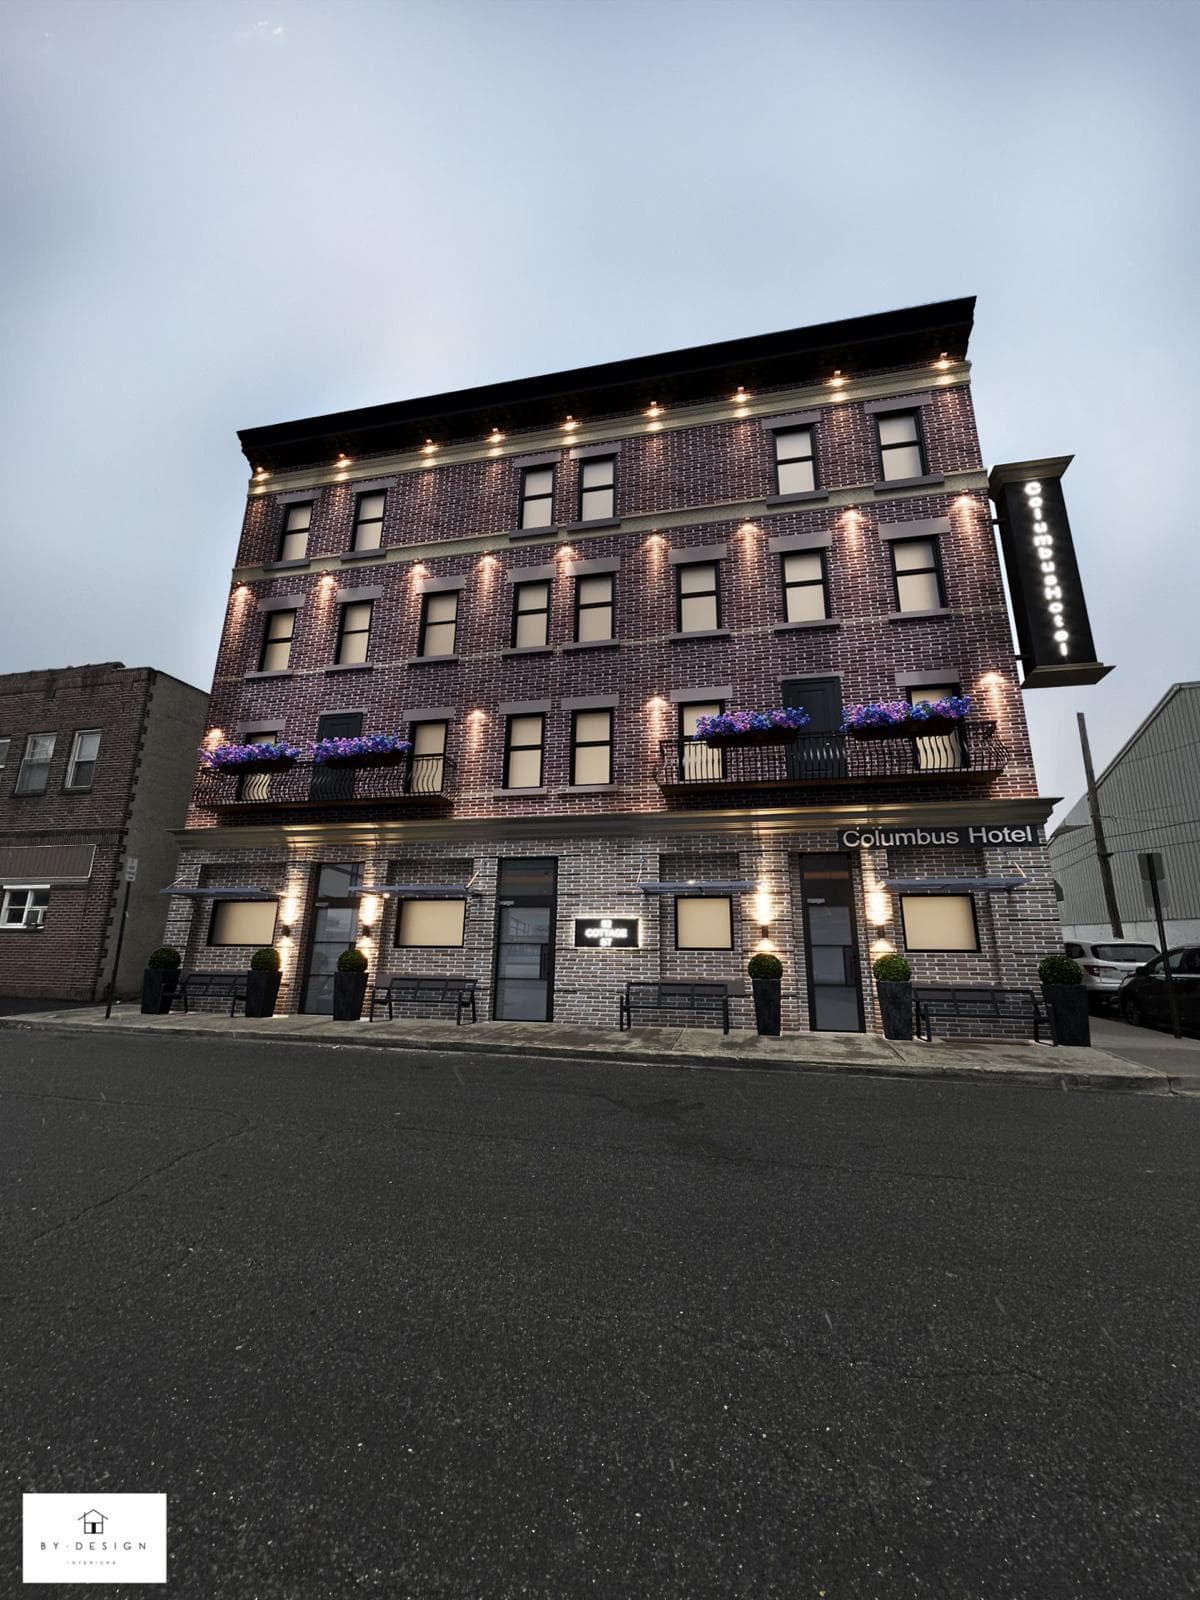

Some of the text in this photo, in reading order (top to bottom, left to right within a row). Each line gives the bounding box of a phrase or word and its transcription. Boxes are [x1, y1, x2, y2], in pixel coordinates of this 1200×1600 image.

[842, 825, 1033, 848] Columbus Hotel
[584, 928, 628, 938] COTTAGE
